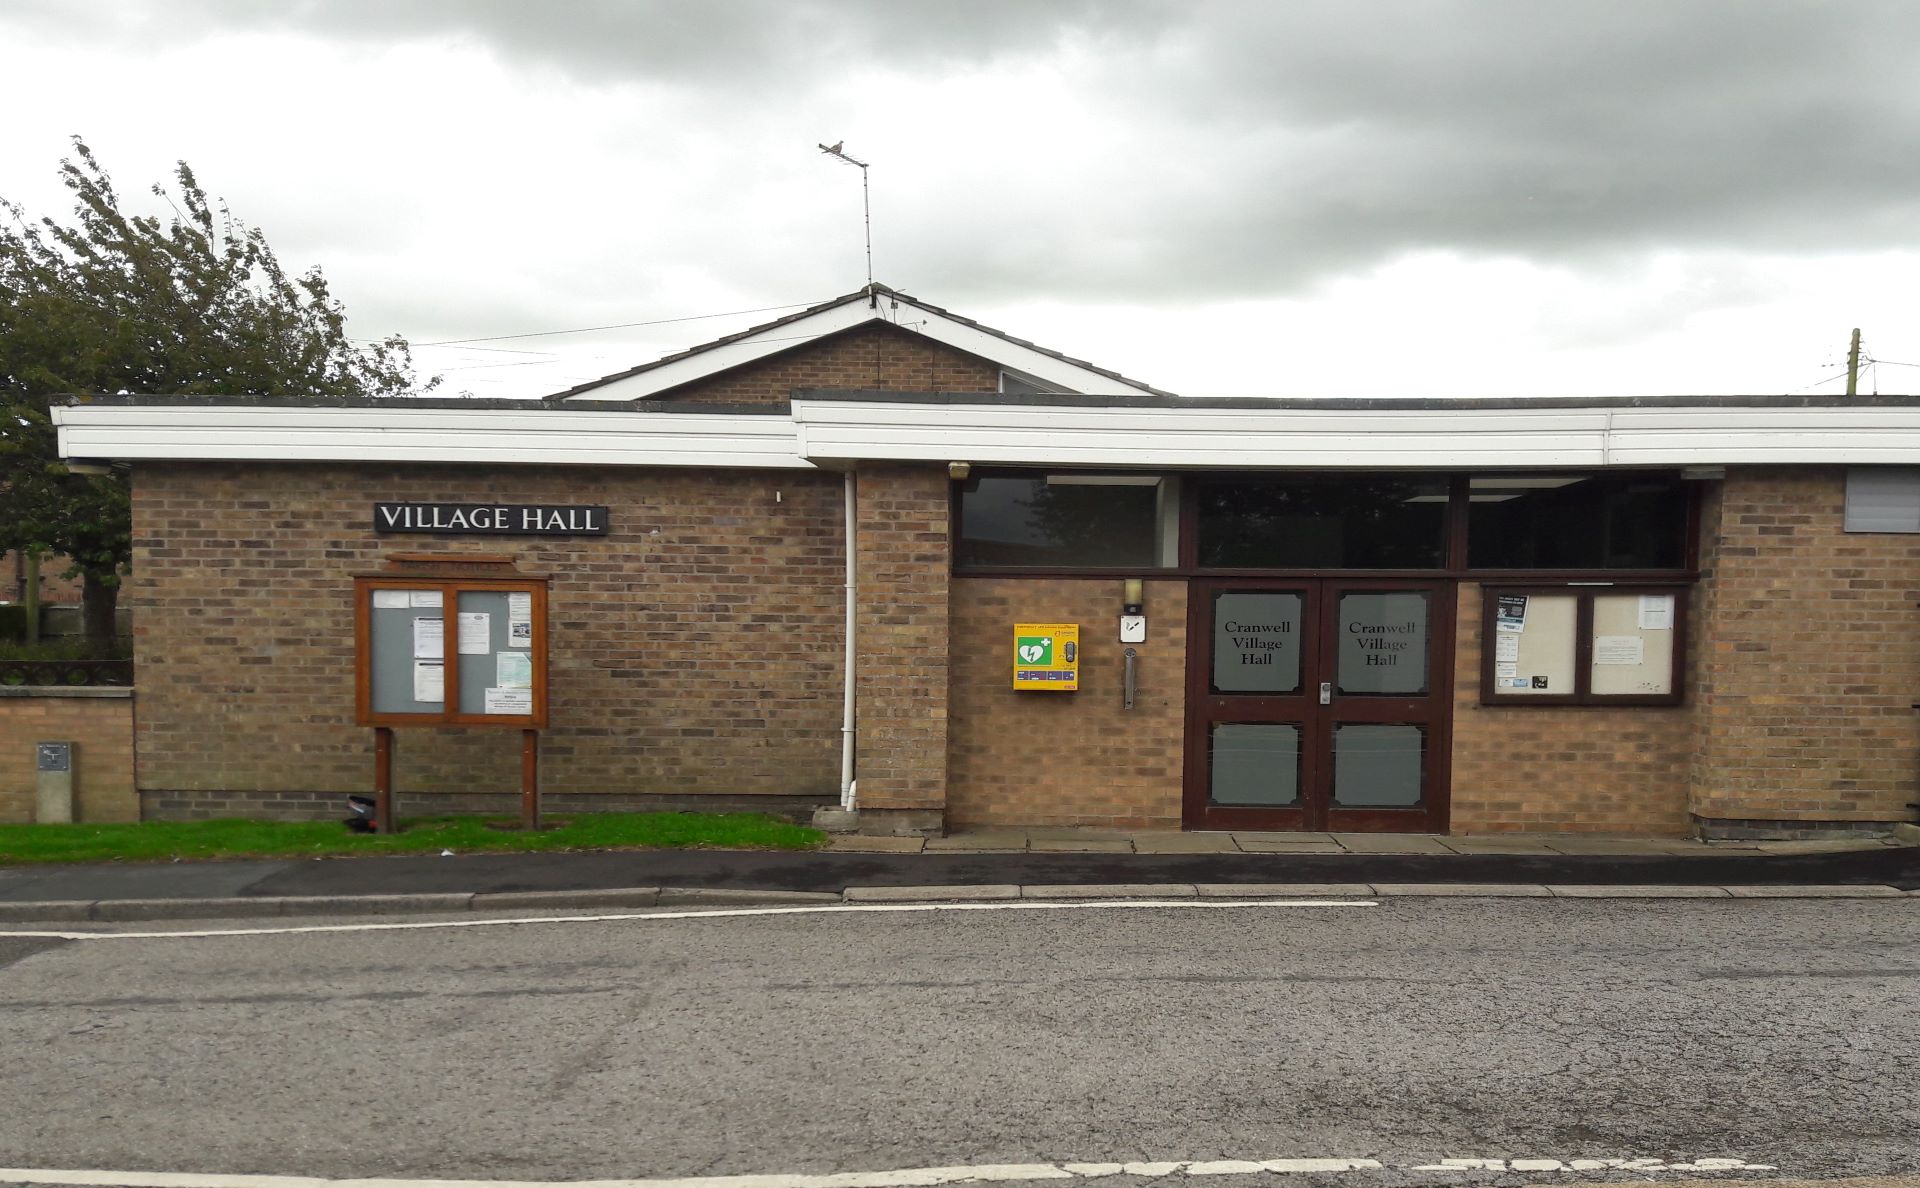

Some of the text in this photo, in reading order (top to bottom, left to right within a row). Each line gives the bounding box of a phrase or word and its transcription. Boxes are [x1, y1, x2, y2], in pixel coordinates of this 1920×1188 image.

[380, 506, 600, 531] VILLAGE HALL
[1224, 621, 1291, 633] Cranwell
[1349, 622, 1416, 634] Cranwell
[1232, 637, 1282, 651] Village
[1357, 638, 1408, 652] Village
[1241, 653, 1272, 665] Hall
[1365, 654, 1397, 667] Hall
